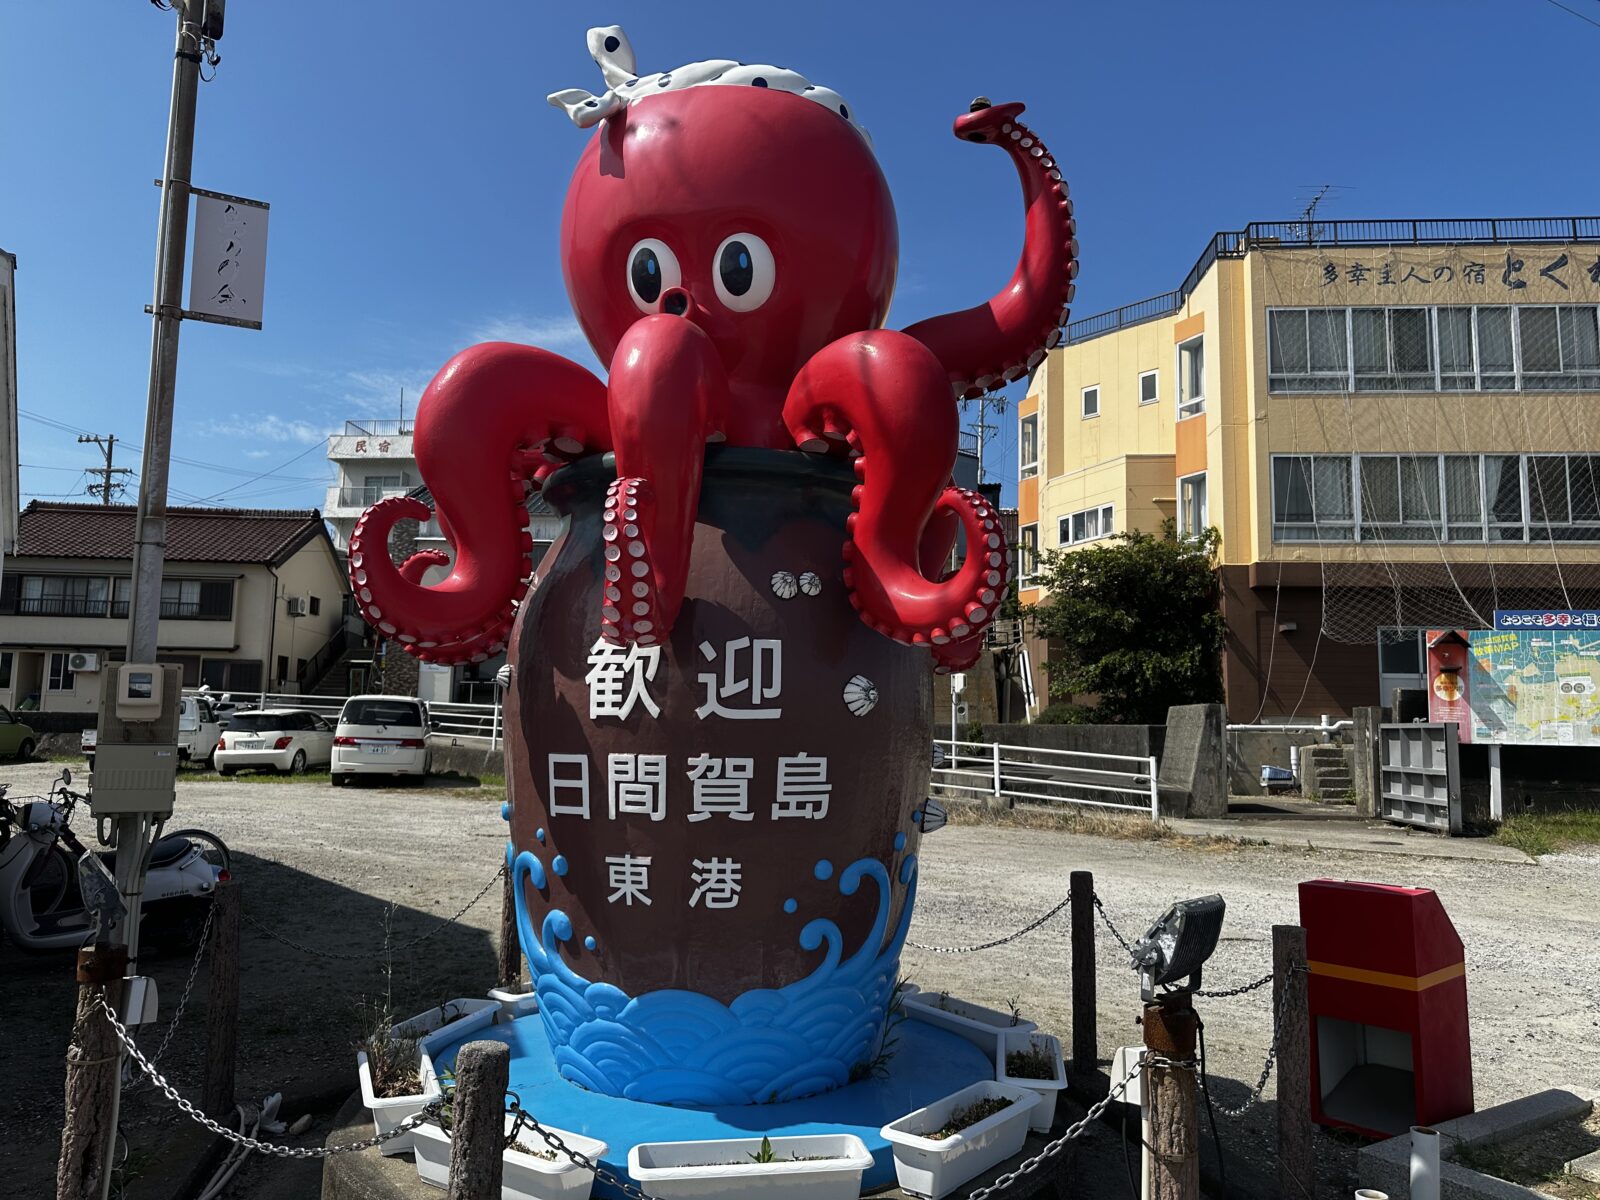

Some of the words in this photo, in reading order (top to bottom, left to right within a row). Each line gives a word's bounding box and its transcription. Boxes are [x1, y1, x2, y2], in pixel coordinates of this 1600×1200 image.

[1319, 261, 1486, 288] 多幸主人の宿
[355, 439, 391, 453] 民宿
[1501, 613, 1600, 627] ようこそ多幸と福
[585, 635, 783, 721] 歓迎
[547, 752, 833, 822] 日間賀島
[604, 853, 743, 910] 東港
